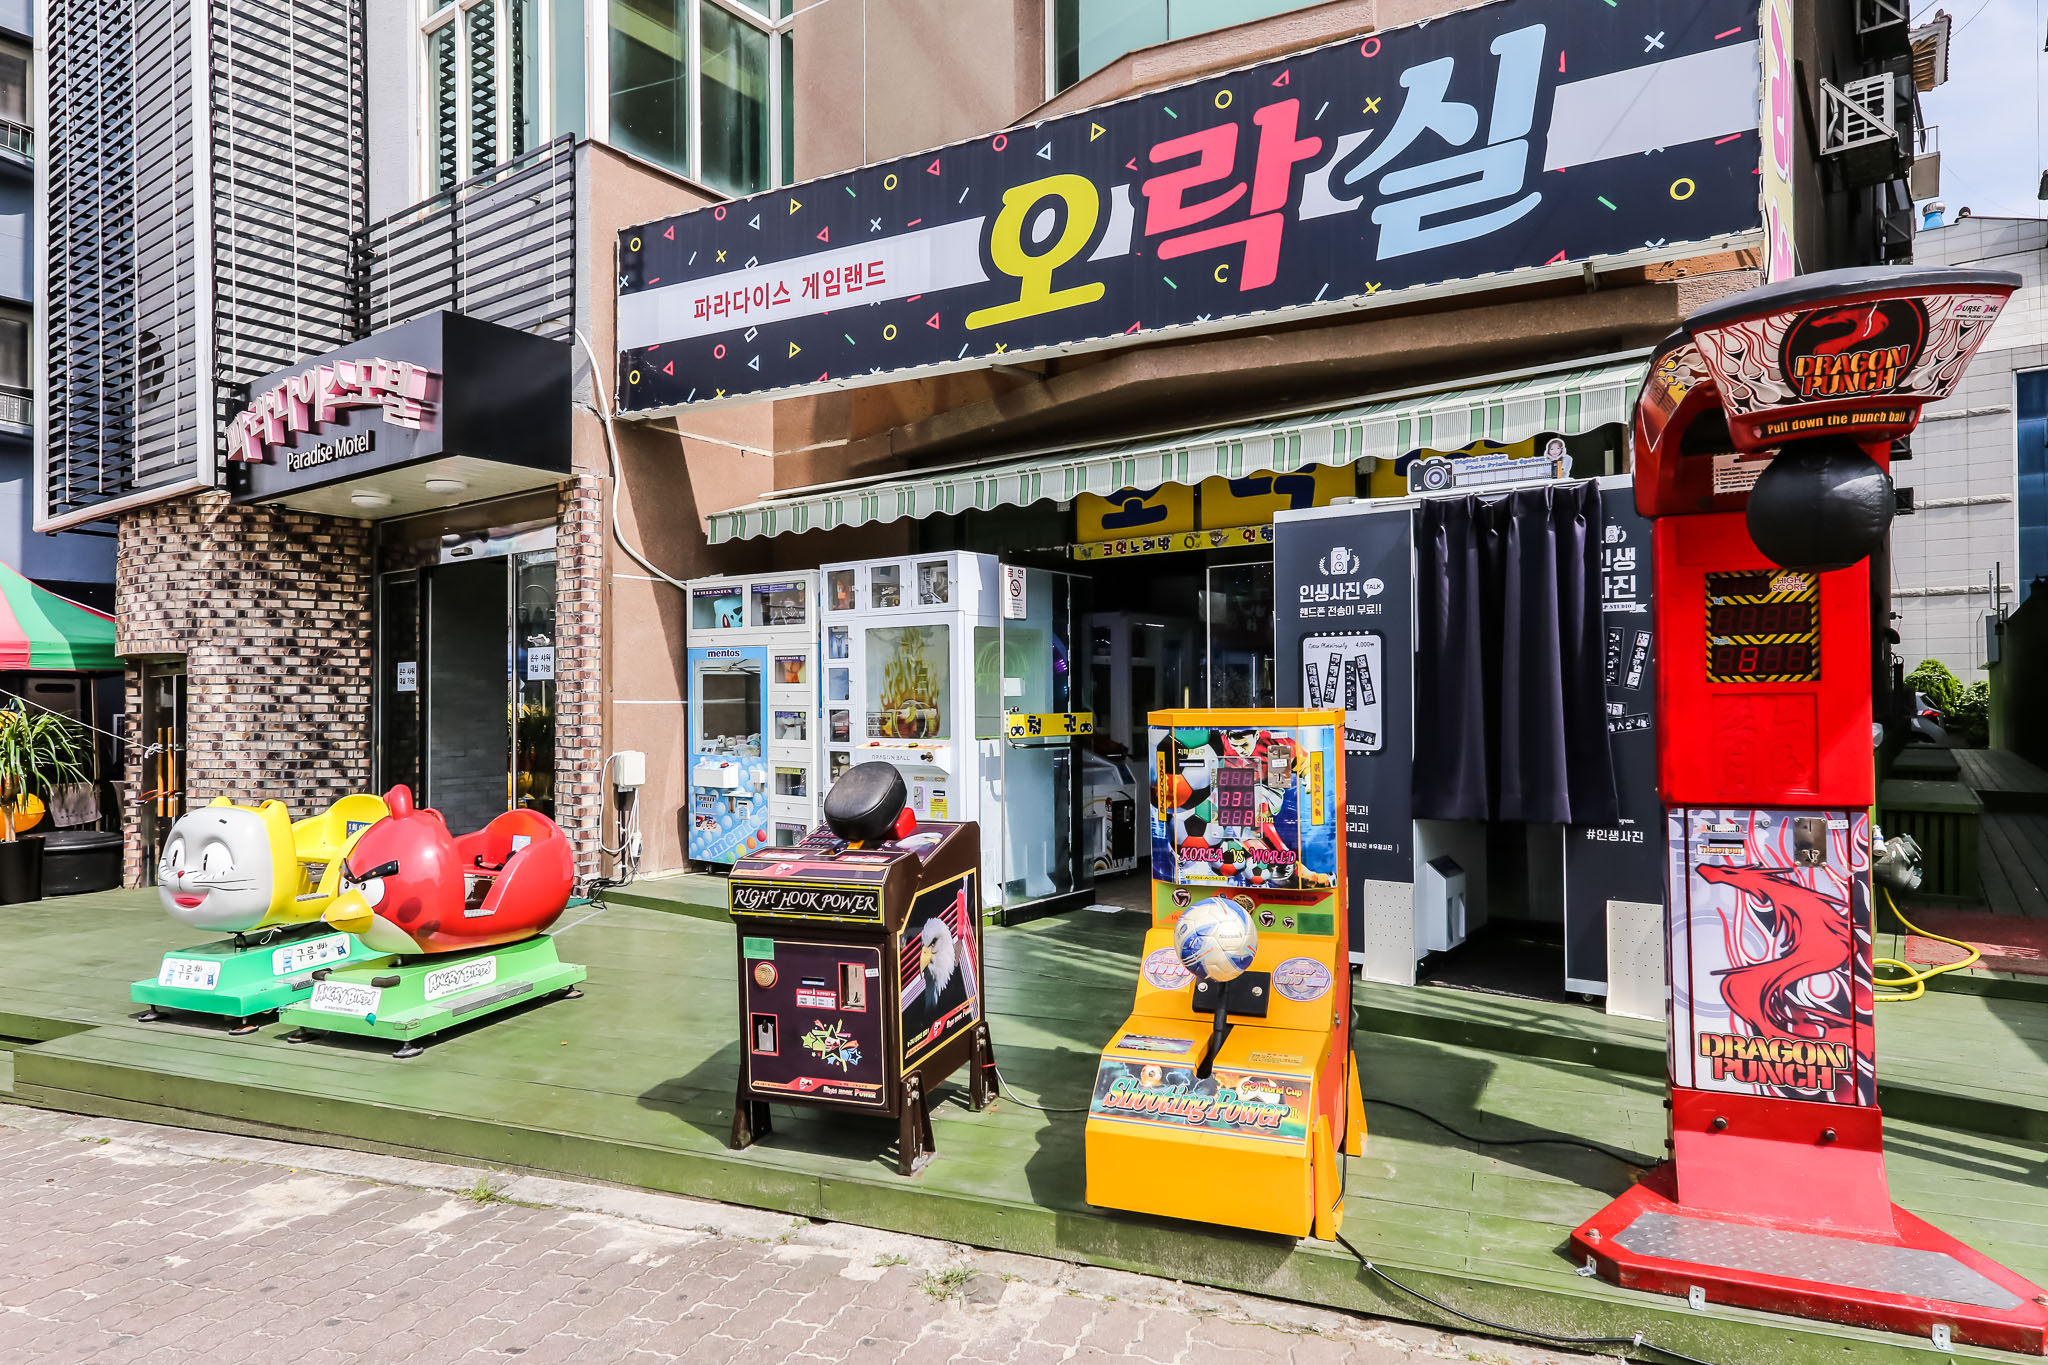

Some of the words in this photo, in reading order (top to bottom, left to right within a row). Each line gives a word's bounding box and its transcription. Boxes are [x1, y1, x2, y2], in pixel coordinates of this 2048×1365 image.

[964, 23, 1547, 331] 오락실
[694, 281, 790, 321] 파라다이스
[801, 260, 886, 299] 게임랜드
[1795, 345, 1909, 379] DRAGON
[1802, 367, 1896, 397] PUNCH
[225, 357, 429, 463] 파라다이스모텔
[1768, 422, 1788, 434] Pull
[1792, 417, 1823, 430] down
[1828, 415, 1847, 426] the
[1852, 411, 1886, 424] punch
[1889, 411, 1905, 422] ball
[287, 443, 333, 472] Paradise
[335, 430, 370, 456] Motel
[1104, 537, 1171, 557] 코인노래방
[1300, 582, 1360, 603] 인생사진
[1772, 583, 1807, 591] SCORE
[1328, 605, 1354, 617] 전송이
[1357, 604, 1382, 615] 무료!!
[707, 648, 741, 658] mentos
[541, 664, 550, 672] 가능
[1346, 822, 1369, 833] 리고!
[1586, 829, 1644, 843] #인생사진
[1180, 848, 1225, 862] KOREA
[1230, 848, 1245, 863] VS
[1250, 848, 1297, 864] WORLD
[734, 888, 780, 909] RIGHT
[773, 890, 823, 912] HOOK
[822, 894, 878, 913] POWER
[429, 970, 461, 993] ANGRY
[461, 961, 491, 982] BIRDS
[315, 984, 345, 1003] ANGRY
[346, 988, 376, 1005] BIRDS
[1700, 1033, 1848, 1068] DRAGON
[1711, 1058, 1834, 1090] PUNCH
[1260, 1082, 1283, 1095] World
[1286, 1086, 1303, 1098] Cup
[1103, 1076, 1212, 1124] Shooting
[1207, 1088, 1291, 1129] Power
